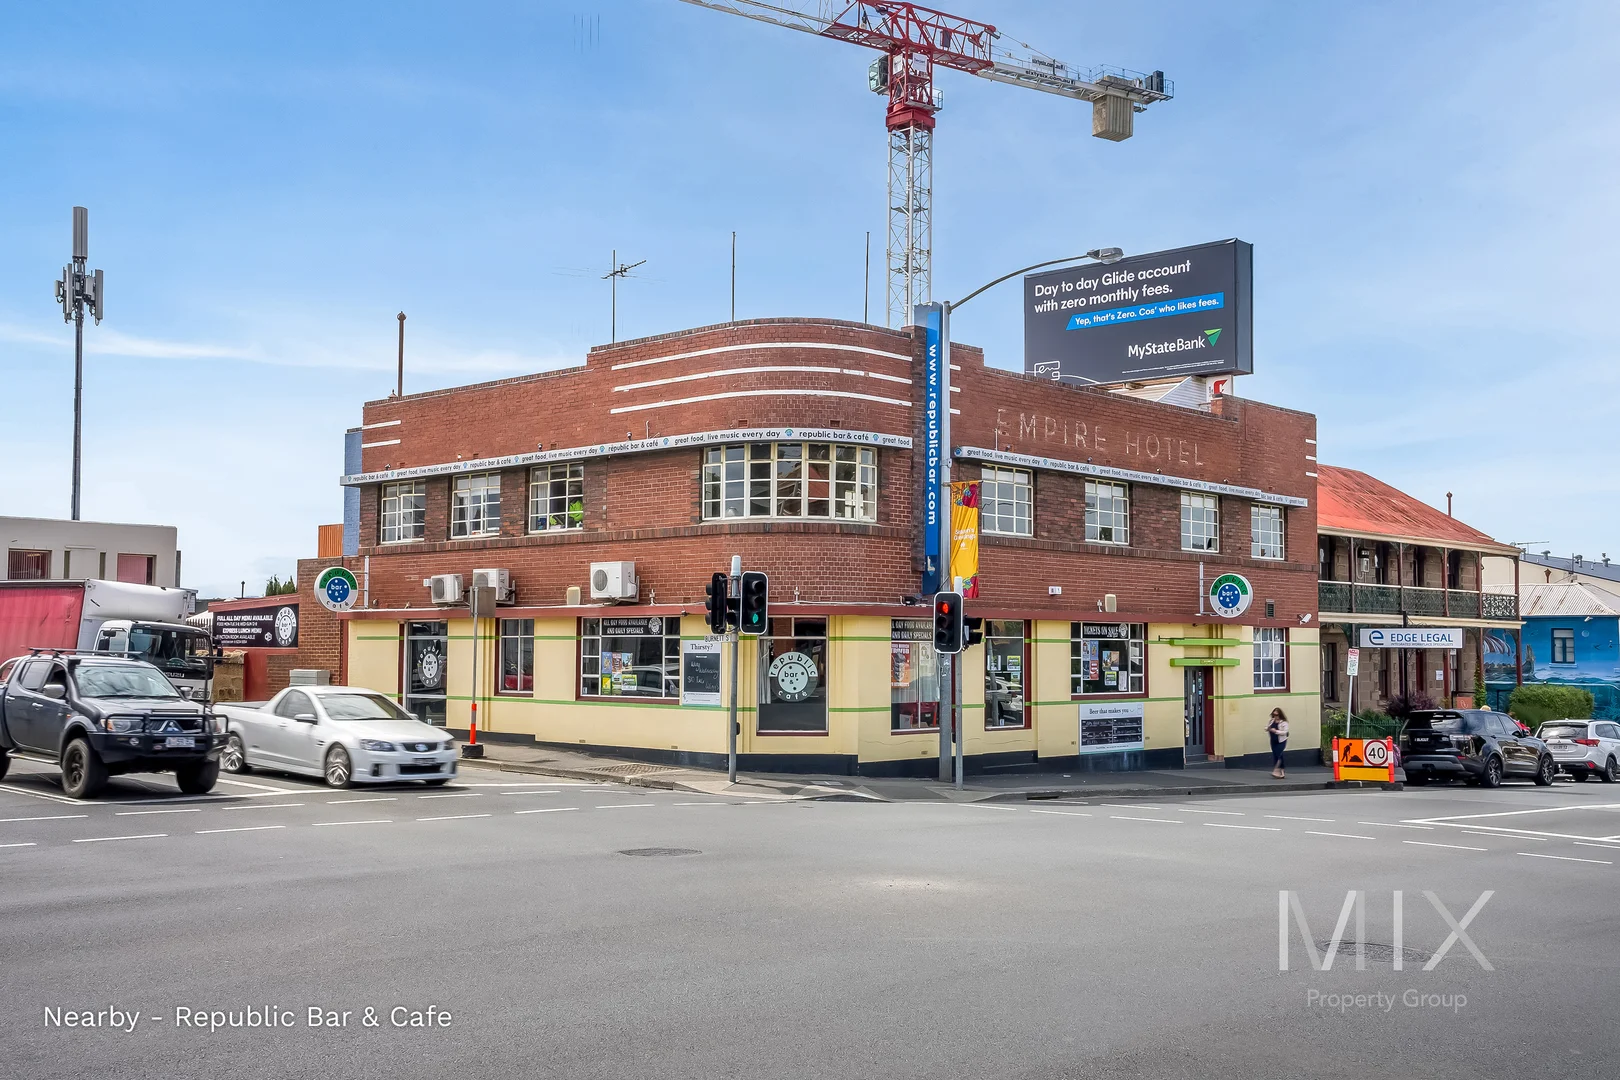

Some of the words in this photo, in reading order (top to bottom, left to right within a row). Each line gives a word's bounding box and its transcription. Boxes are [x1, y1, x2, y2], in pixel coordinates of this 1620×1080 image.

[1034, 284, 1058, 299] Day
[1061, 282, 1074, 293] to
[1076, 278, 1099, 294] day
[1102, 270, 1134, 286] Glide
[1139, 260, 1192, 280] account
[1034, 301, 1058, 314] with
[1060, 298, 1086, 310] zero
[1089, 286, 1139, 306] monthly
[1142, 282, 1173, 298] fees.
[1075, 316, 1092, 327] Yep,
[1093, 312, 1114, 323] that's
[1116, 310, 1137, 320] Zero.
[1138, 306, 1158, 316] Cos'
[1159, 304, 1176, 314] who
[1177, 300, 1197, 311] likes
[1198, 298, 1220, 308] fees.
[1128, 336, 1206, 360] MyStateBank
[608, 443, 630, 452] republic
[674, 436, 689, 445] great
[742, 430, 764, 438] every
[766, 430, 781, 438] day
[800, 430, 832, 439] republic
[854, 433, 869, 441] café
[882, 436, 896, 445] great
[898, 438, 912, 446] food,
[928, 343, 937, 526] www.republicbar.com
[996, 408, 1106, 450] EMPIRE
[1126, 432, 1204, 466] HOTEL
[892, 631, 900, 639] AND
[901, 631, 912, 639] DAILY
[913, 631, 932, 640] SPECIALS
[1390, 634, 1417, 642] EDGE
[1421, 634, 1454, 642] LEGAL
[418, 646, 442, 664] republic
[690, 643, 714, 652] Thirsty?
[770, 654, 816, 676] republic
[778, 690, 808, 700] café
[1368, 748, 1386, 758] 40
